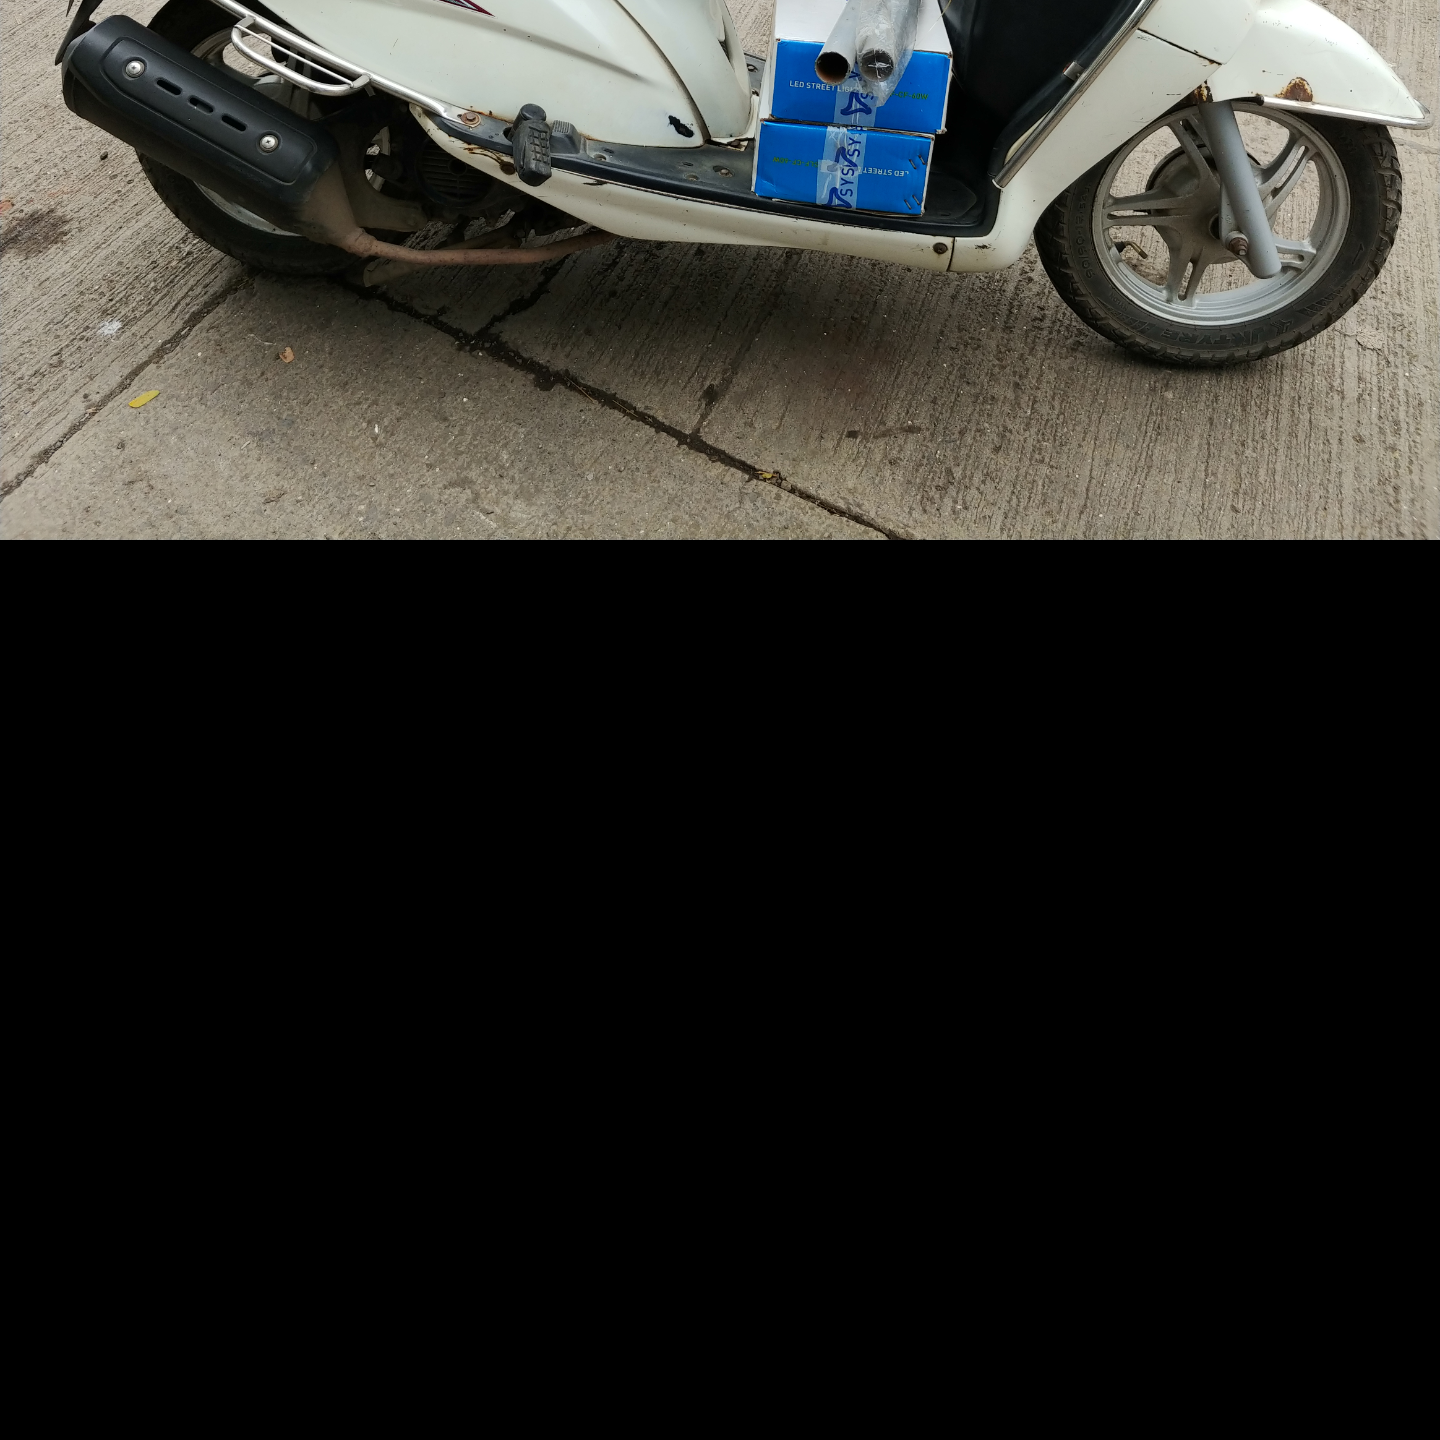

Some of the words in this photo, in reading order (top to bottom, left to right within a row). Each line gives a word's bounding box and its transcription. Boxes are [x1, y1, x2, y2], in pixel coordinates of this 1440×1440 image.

[789, 80, 805, 88] LED
[806, 82, 835, 91] STREET
[890, 91, 929, 100] F-CF-60W
[862, 167, 893, 176] STREET
[894, 169, 909, 177] LED
